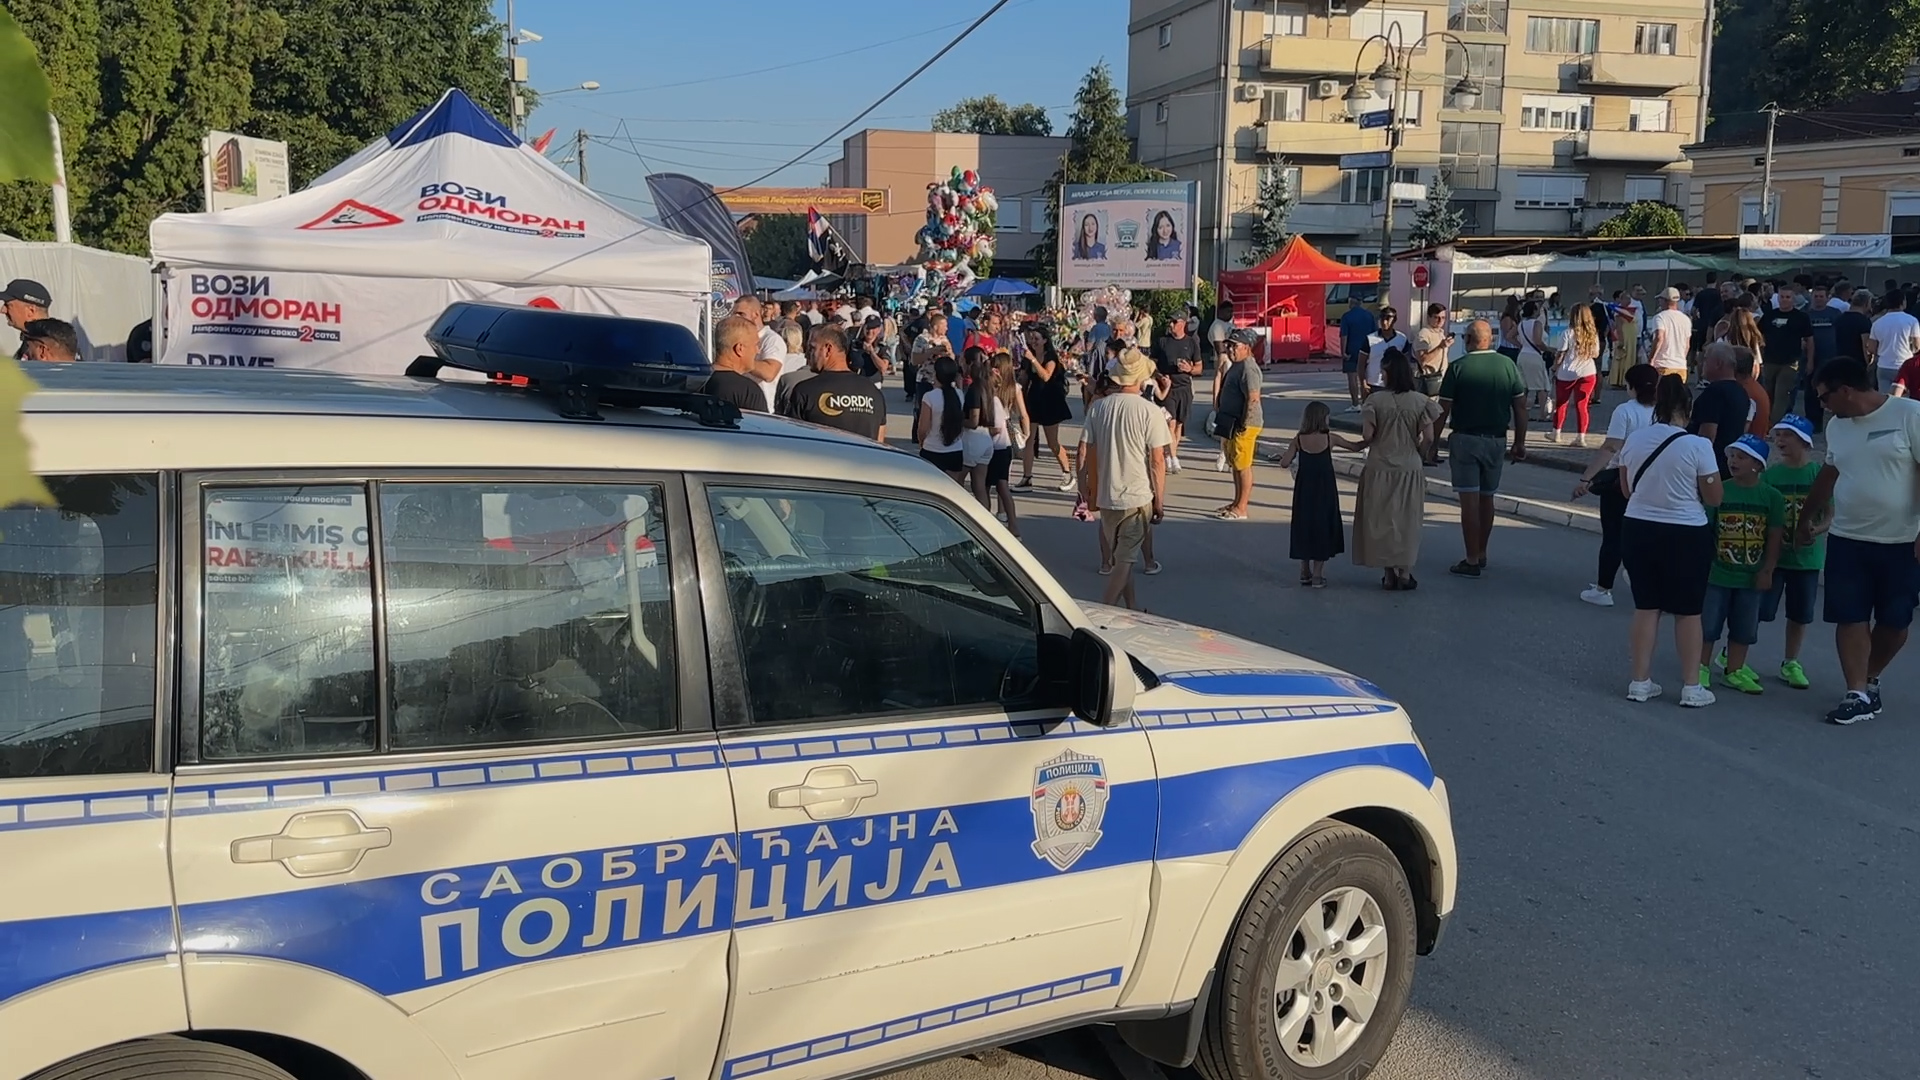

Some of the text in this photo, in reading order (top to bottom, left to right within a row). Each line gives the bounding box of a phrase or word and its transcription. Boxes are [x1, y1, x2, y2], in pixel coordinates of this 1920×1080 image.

[420, 182, 507, 208] ВОЗИ
[417, 195, 585, 231] ОДМОРАН
[191, 274, 270, 296] ВОЗИ
[191, 296, 341, 324] ОДМОРАН
[299, 325, 314, 343] 2
[1281, 333, 1301, 343] mts
[187, 353, 275, 368] DRIVE
[829, 395, 874, 410] NORDIC
[1045, 763, 1094, 779] ПОЛИЦИЈА
[419, 808, 961, 906] САОБРАЋАЈНА
[419, 842, 962, 981] ПОЛИЦИЈА
